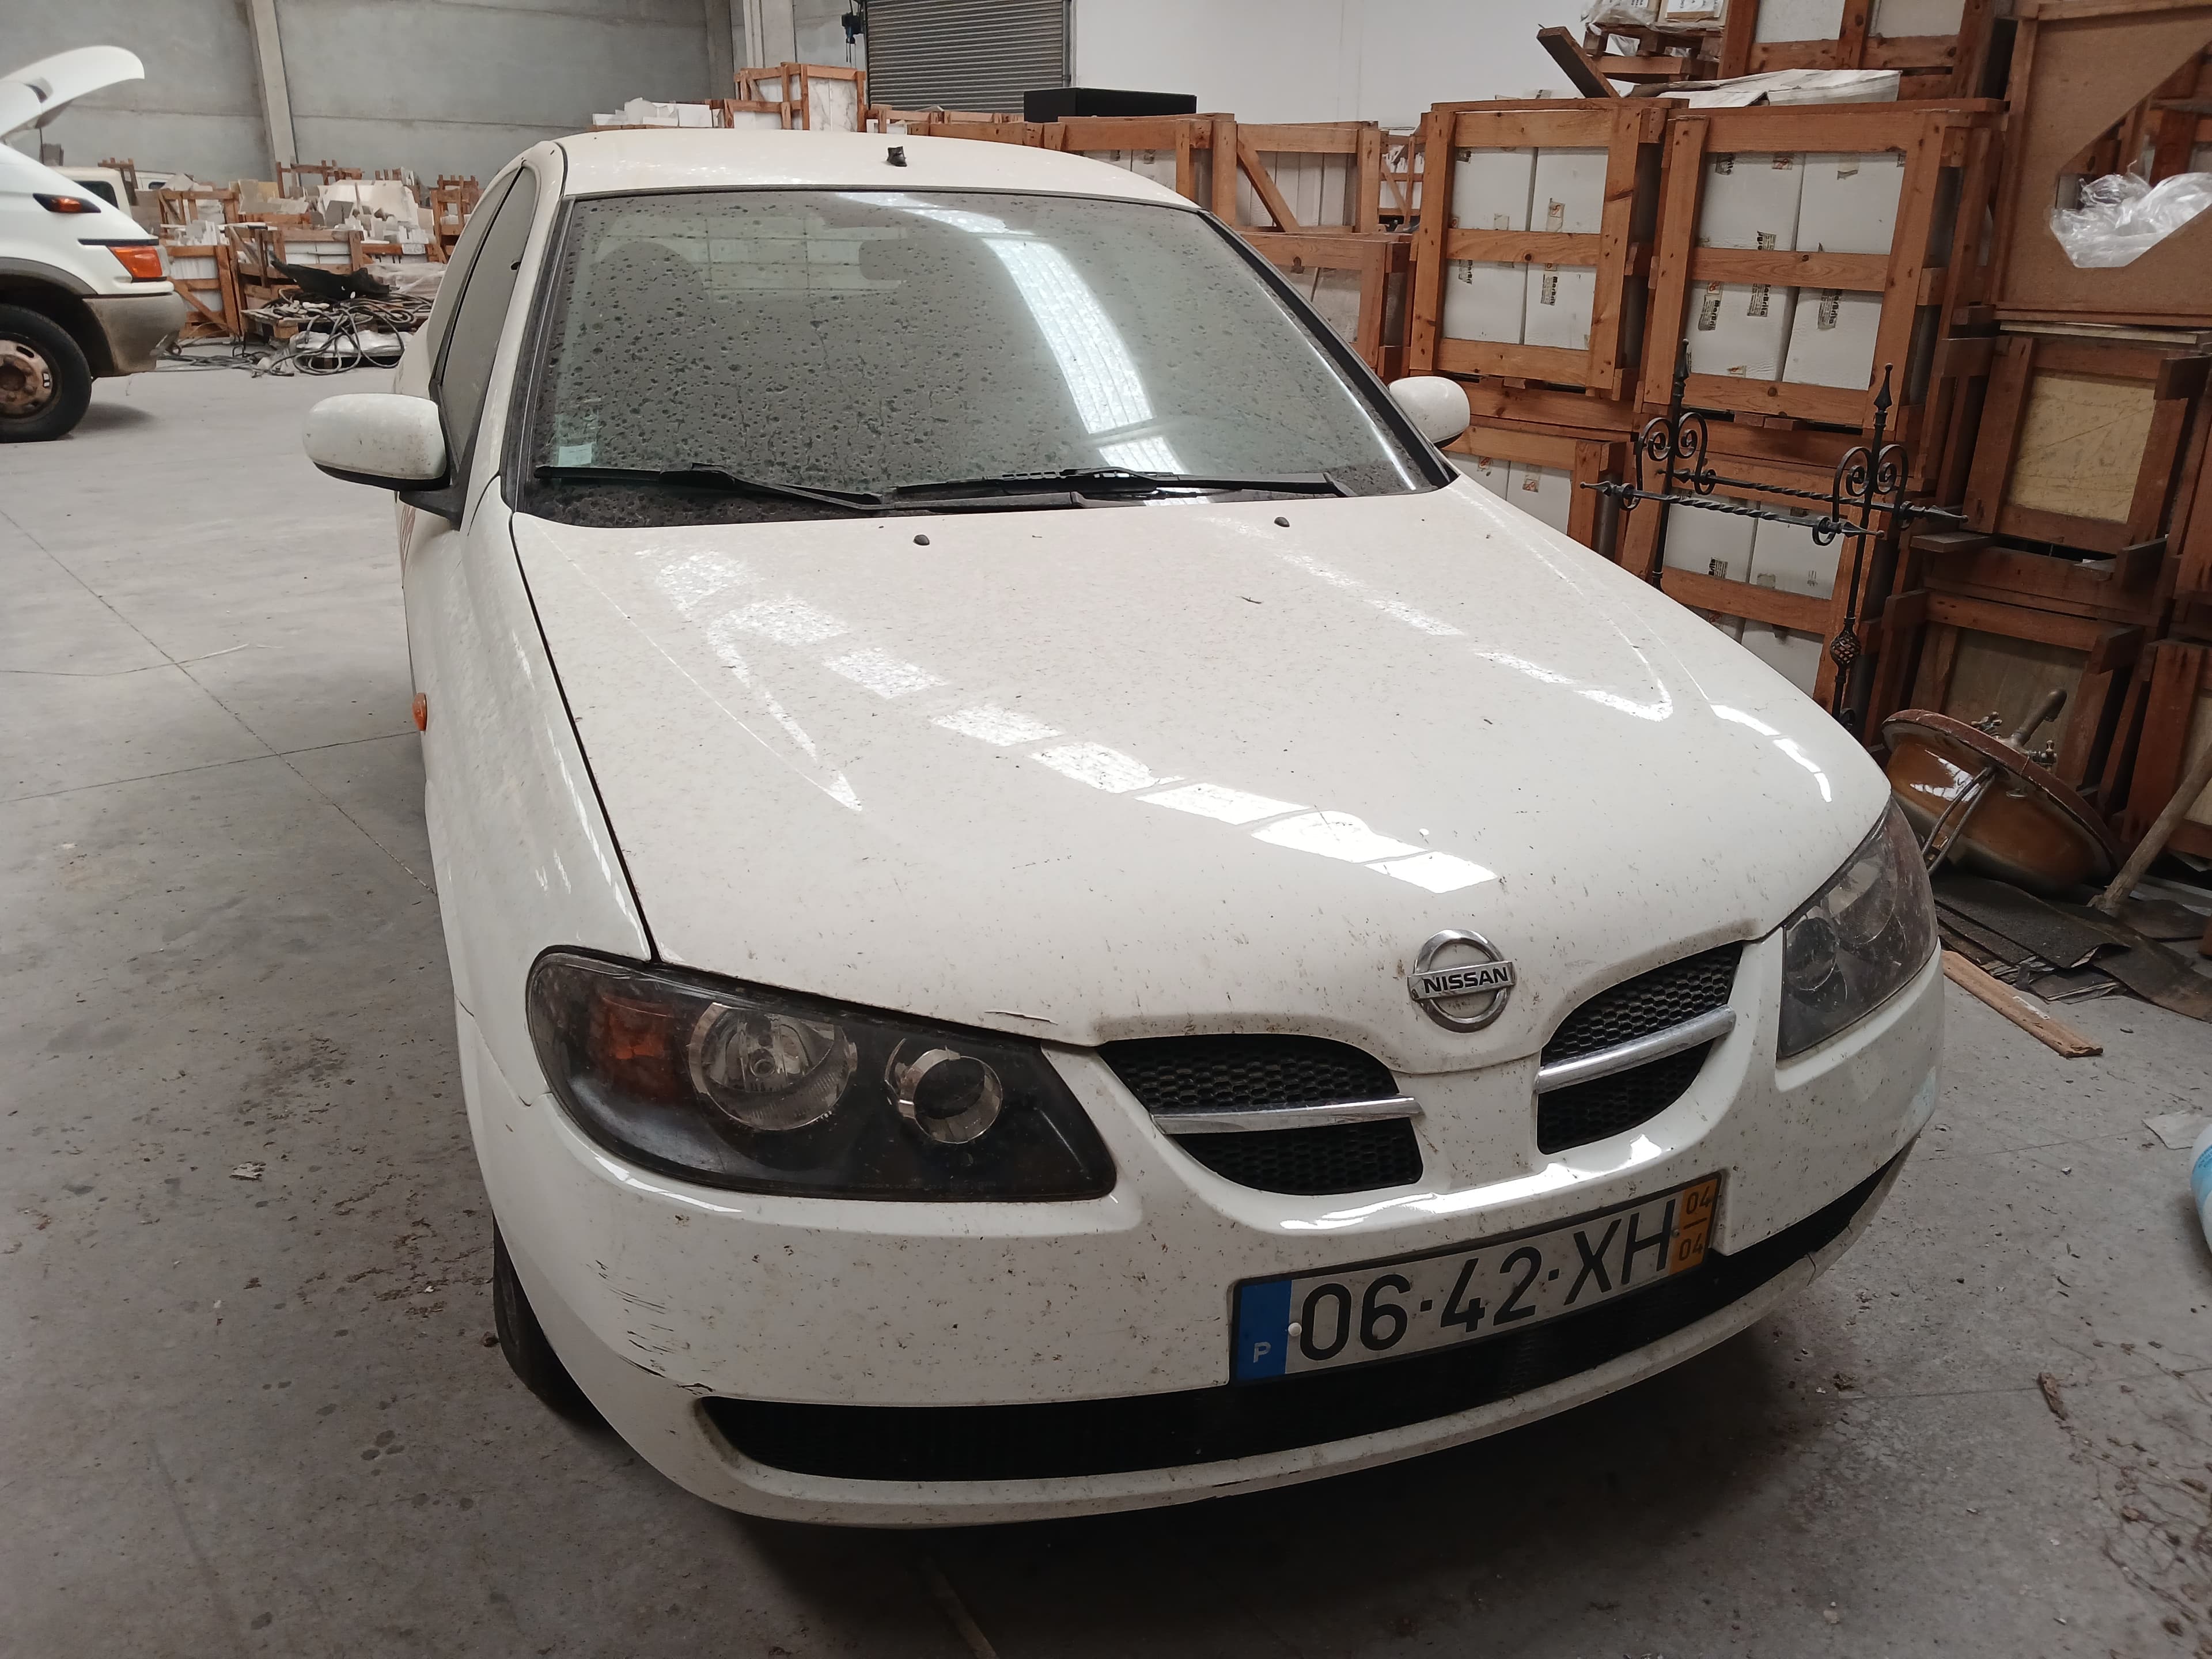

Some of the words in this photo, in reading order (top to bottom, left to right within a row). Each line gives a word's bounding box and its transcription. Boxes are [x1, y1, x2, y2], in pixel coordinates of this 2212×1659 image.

[1423, 967, 1509, 994] NISSAN
[1686, 1185, 1713, 1215] 04
[1678, 1232, 1703, 1262] 04
[1252, 1341, 1271, 1363] P
